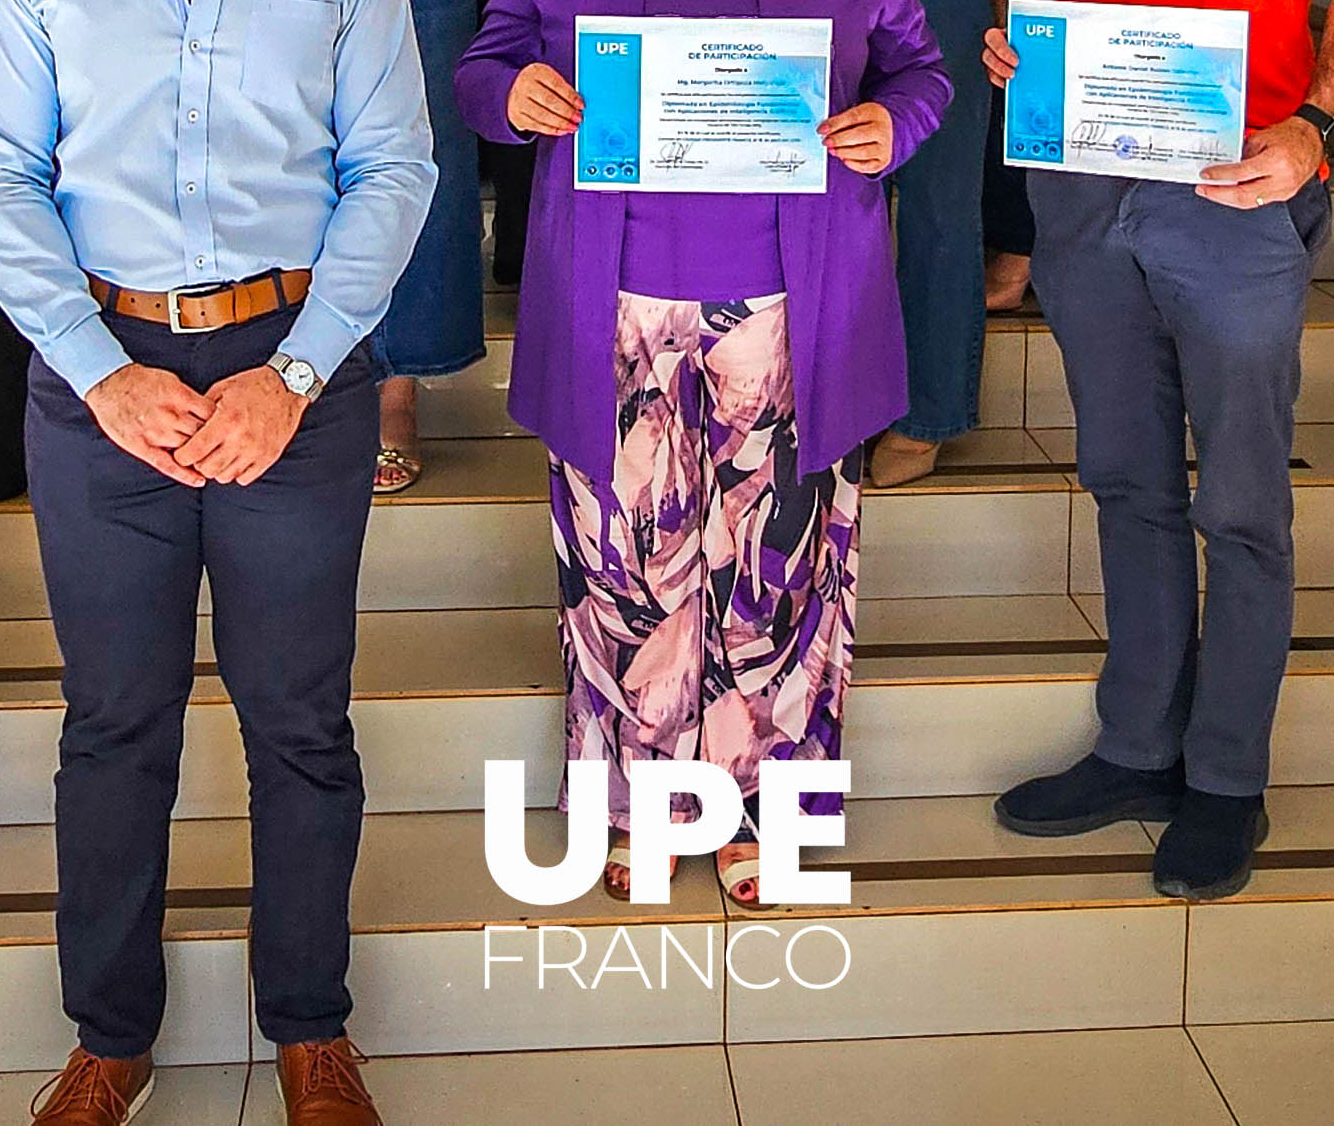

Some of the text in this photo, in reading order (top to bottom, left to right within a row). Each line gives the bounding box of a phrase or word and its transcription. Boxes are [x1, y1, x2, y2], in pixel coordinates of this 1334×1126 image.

[1025, 24, 1055, 38] UPE
[1121, 29, 1181, 40] CERTIFICADO
[596, 41, 628, 55] UPE
[701, 43, 764, 51] CERTIFICADO
[1108, 37, 1193, 50] DE PARTICIPACIÓN
[688, 51, 777, 60] DE PARTICIPACIÓN
